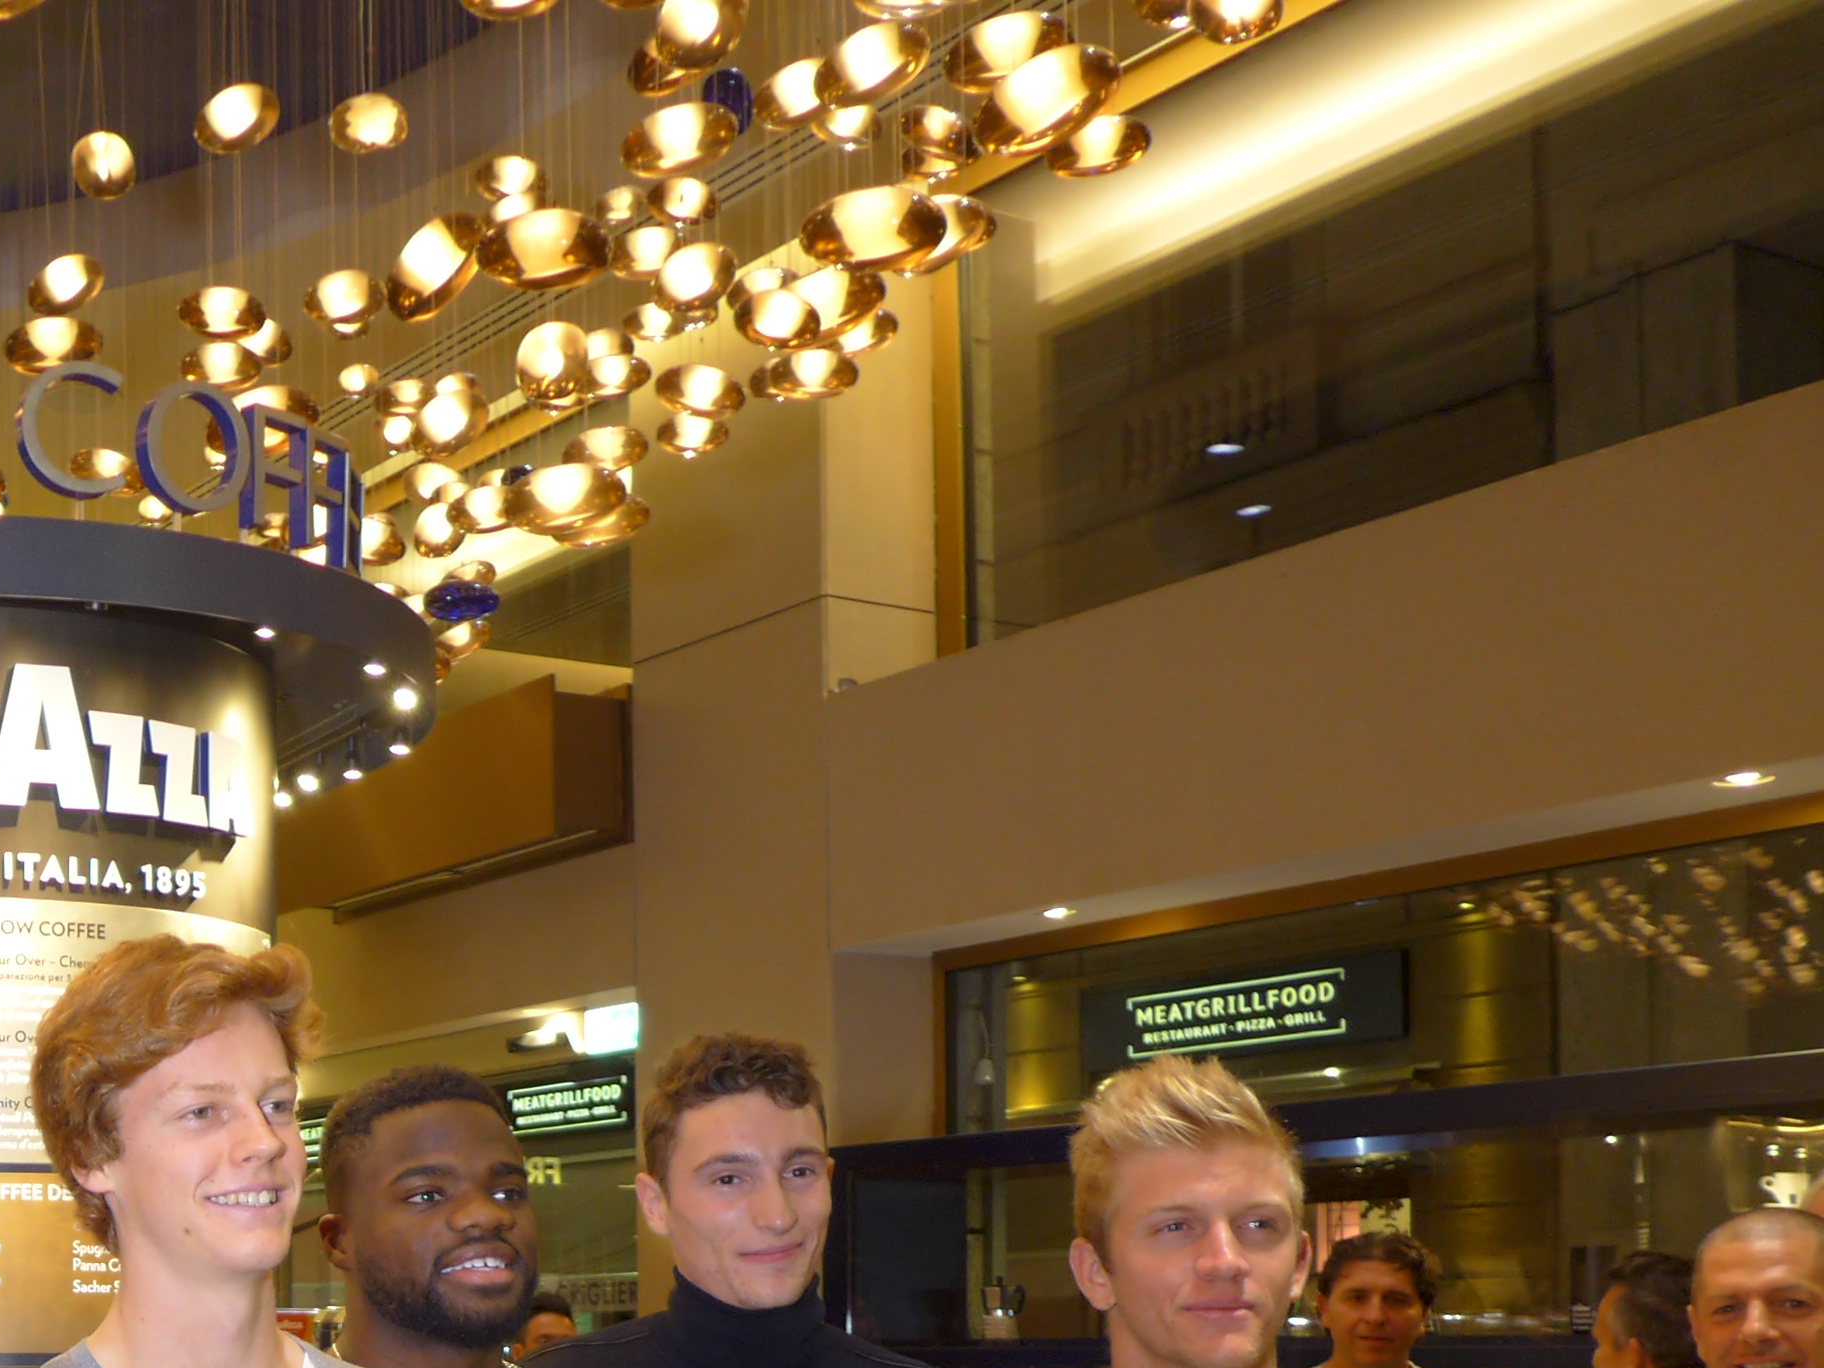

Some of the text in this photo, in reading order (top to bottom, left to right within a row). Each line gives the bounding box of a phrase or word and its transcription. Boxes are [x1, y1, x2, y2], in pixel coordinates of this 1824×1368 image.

[2, 851, 133, 894] ITALIA,
[140, 863, 207, 899] 1895
[39, 922, 107, 940] COFFEE
[16, 954, 46, 966] Over
[48, 974, 63, 983] per
[1134, 981, 1336, 1027] MEATGRILLFOOD
[1142, 1009, 1327, 1046] RESTAURANT PIZZA GRILL
[512, 1084, 622, 1113] MEATGRILLFOOD
[72, 1257, 106, 1272] Panna
[72, 1279, 112, 1294] Sacher
